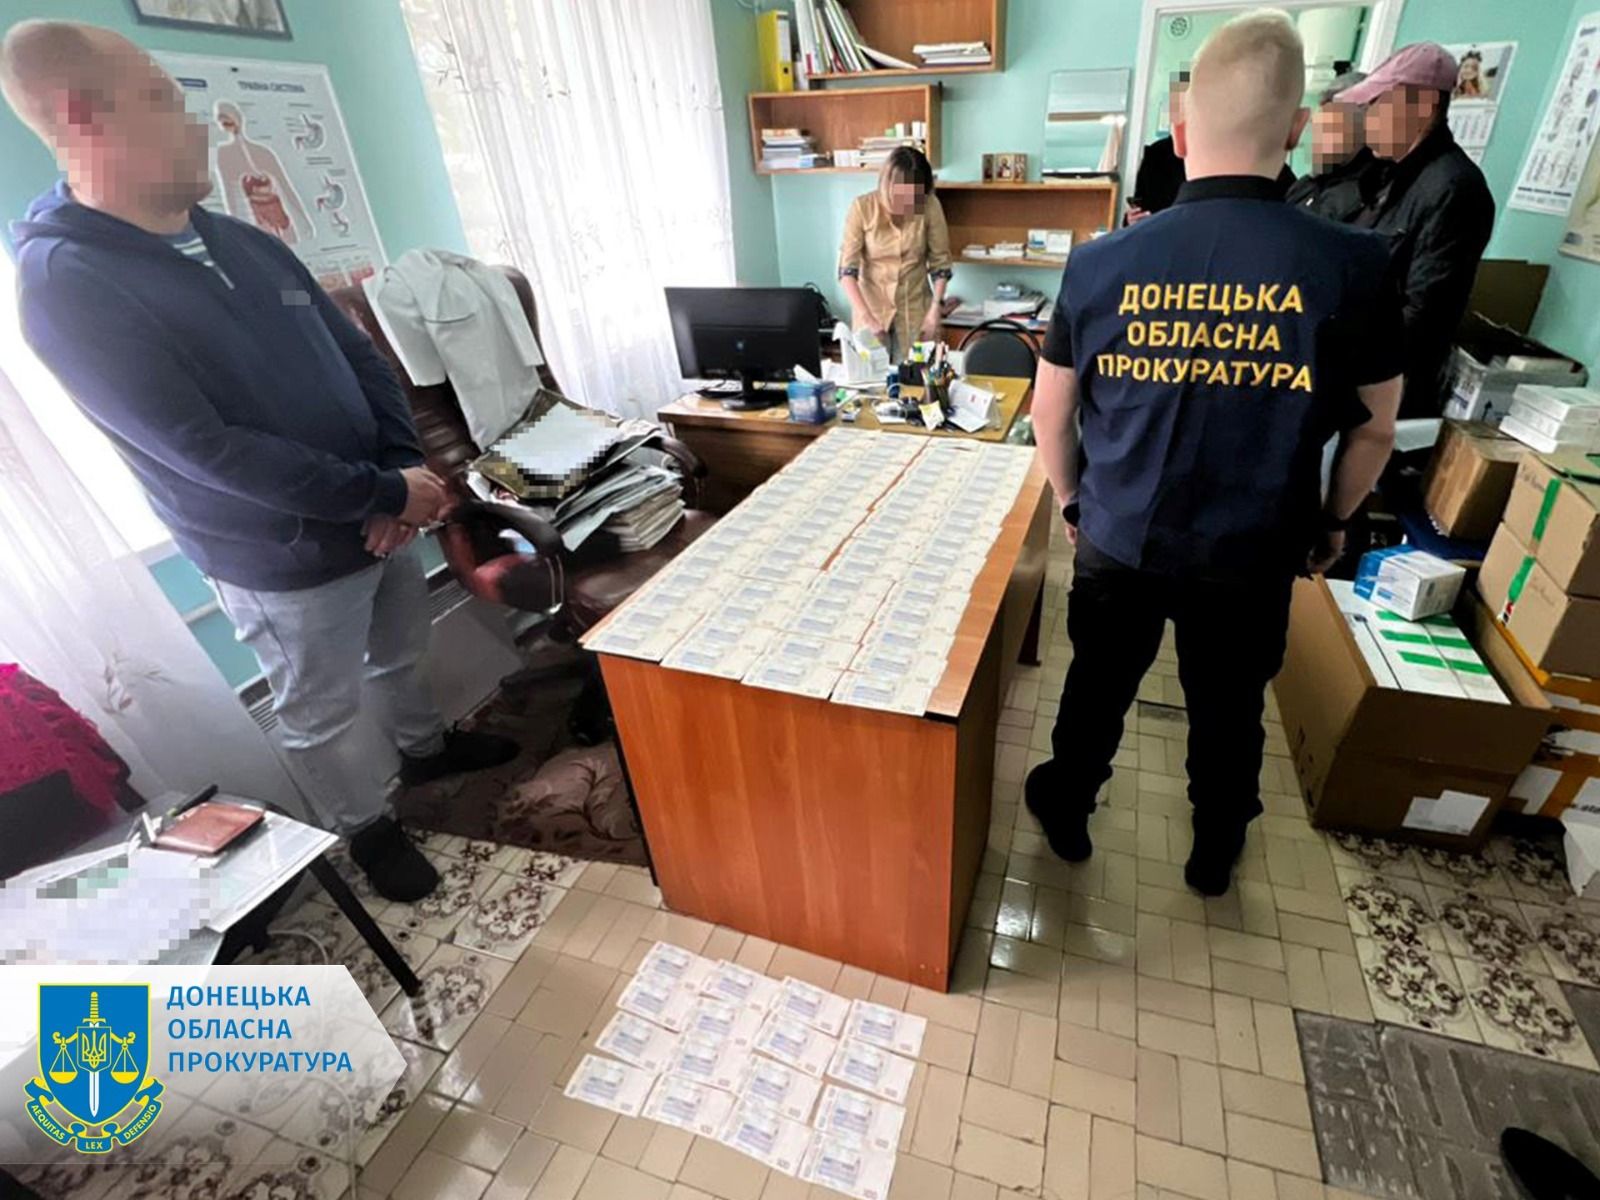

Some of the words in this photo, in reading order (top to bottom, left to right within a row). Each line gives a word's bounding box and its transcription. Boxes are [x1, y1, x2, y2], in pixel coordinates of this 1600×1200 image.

[1117, 283, 1304, 316] ДОНЕЦЬКА
[1127, 321, 1281, 351] ОБЛАСНА
[1097, 354, 1313, 392] ПРОКУРАТУРА
